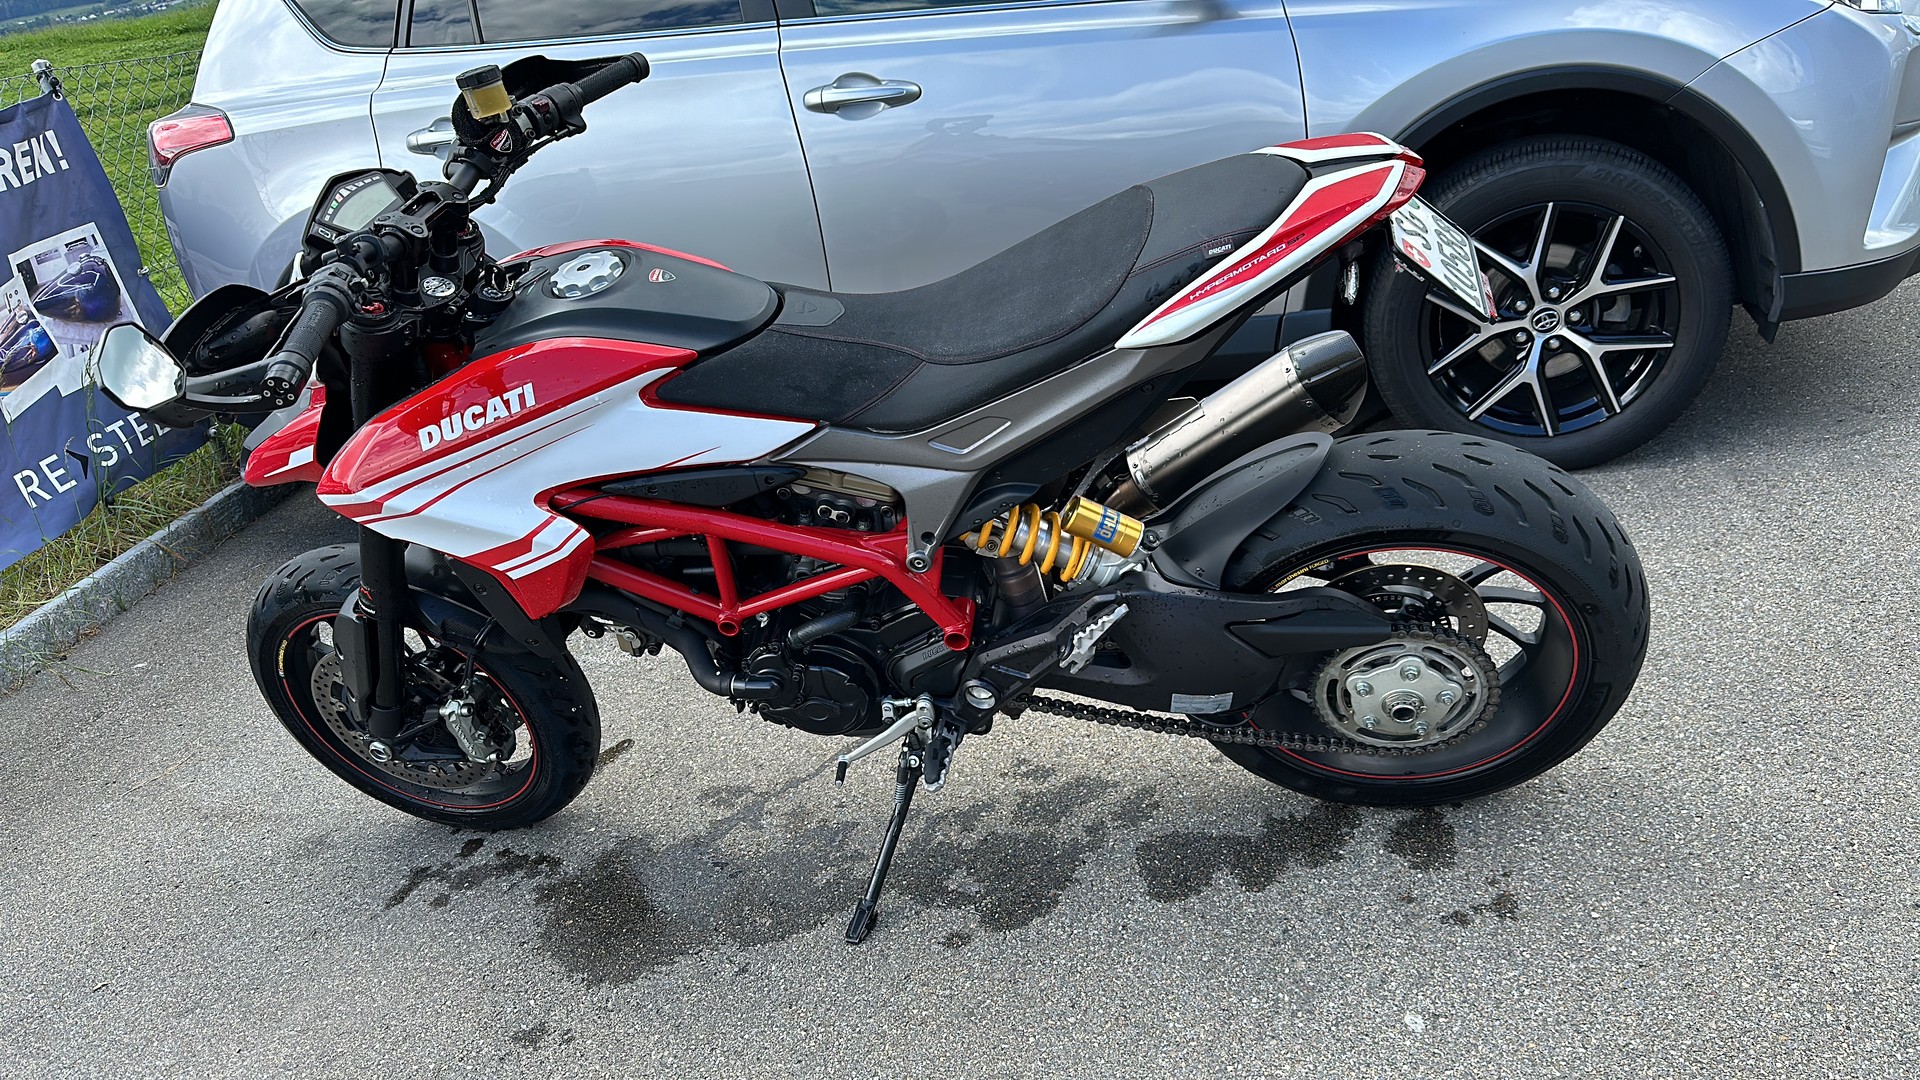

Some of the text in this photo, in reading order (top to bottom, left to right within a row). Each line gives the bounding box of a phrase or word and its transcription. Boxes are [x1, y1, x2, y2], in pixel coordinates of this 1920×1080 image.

[1208, 243, 1232, 256] DUCATI
[1395, 209, 1431, 251] SG
[1189, 243, 1286, 300] HYPERMOTARD
[1432, 214, 1481, 308] 10588
[417, 382, 536, 452] DUCATI
[13, 453, 78, 508] RE
[922, 642, 950, 660] DUCA
